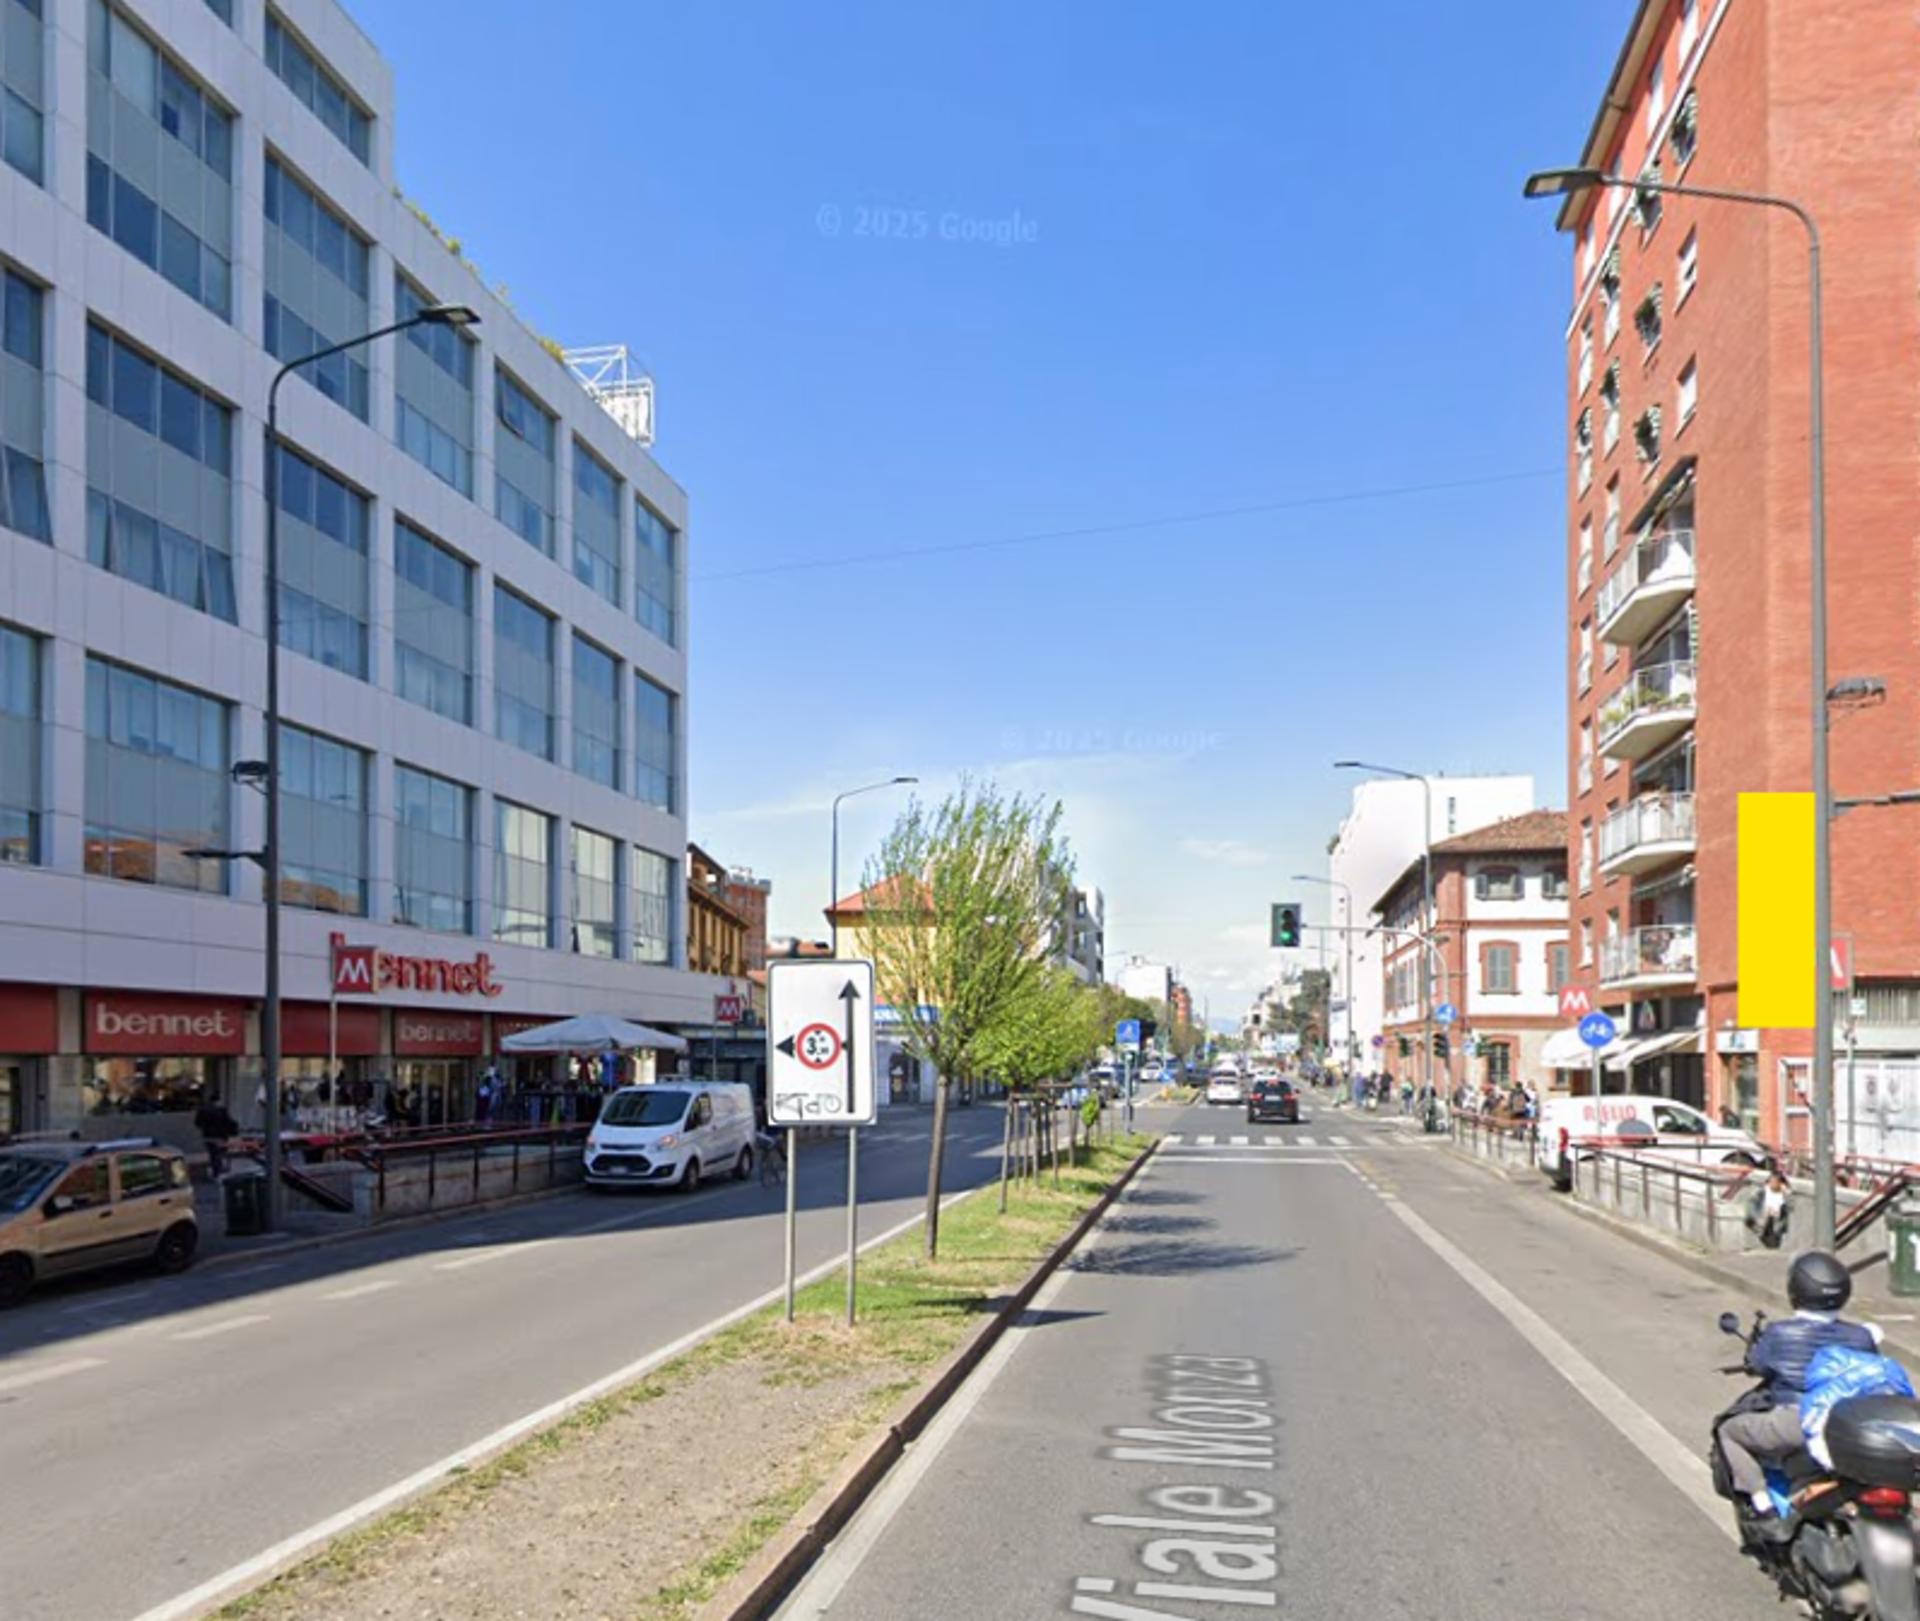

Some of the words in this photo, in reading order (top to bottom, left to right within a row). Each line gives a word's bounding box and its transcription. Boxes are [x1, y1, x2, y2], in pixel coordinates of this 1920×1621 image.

[96, 1003, 236, 1038] bennet
[401, 1018, 478, 1044] bennet
[1108, 1355, 1274, 1468] Monza
